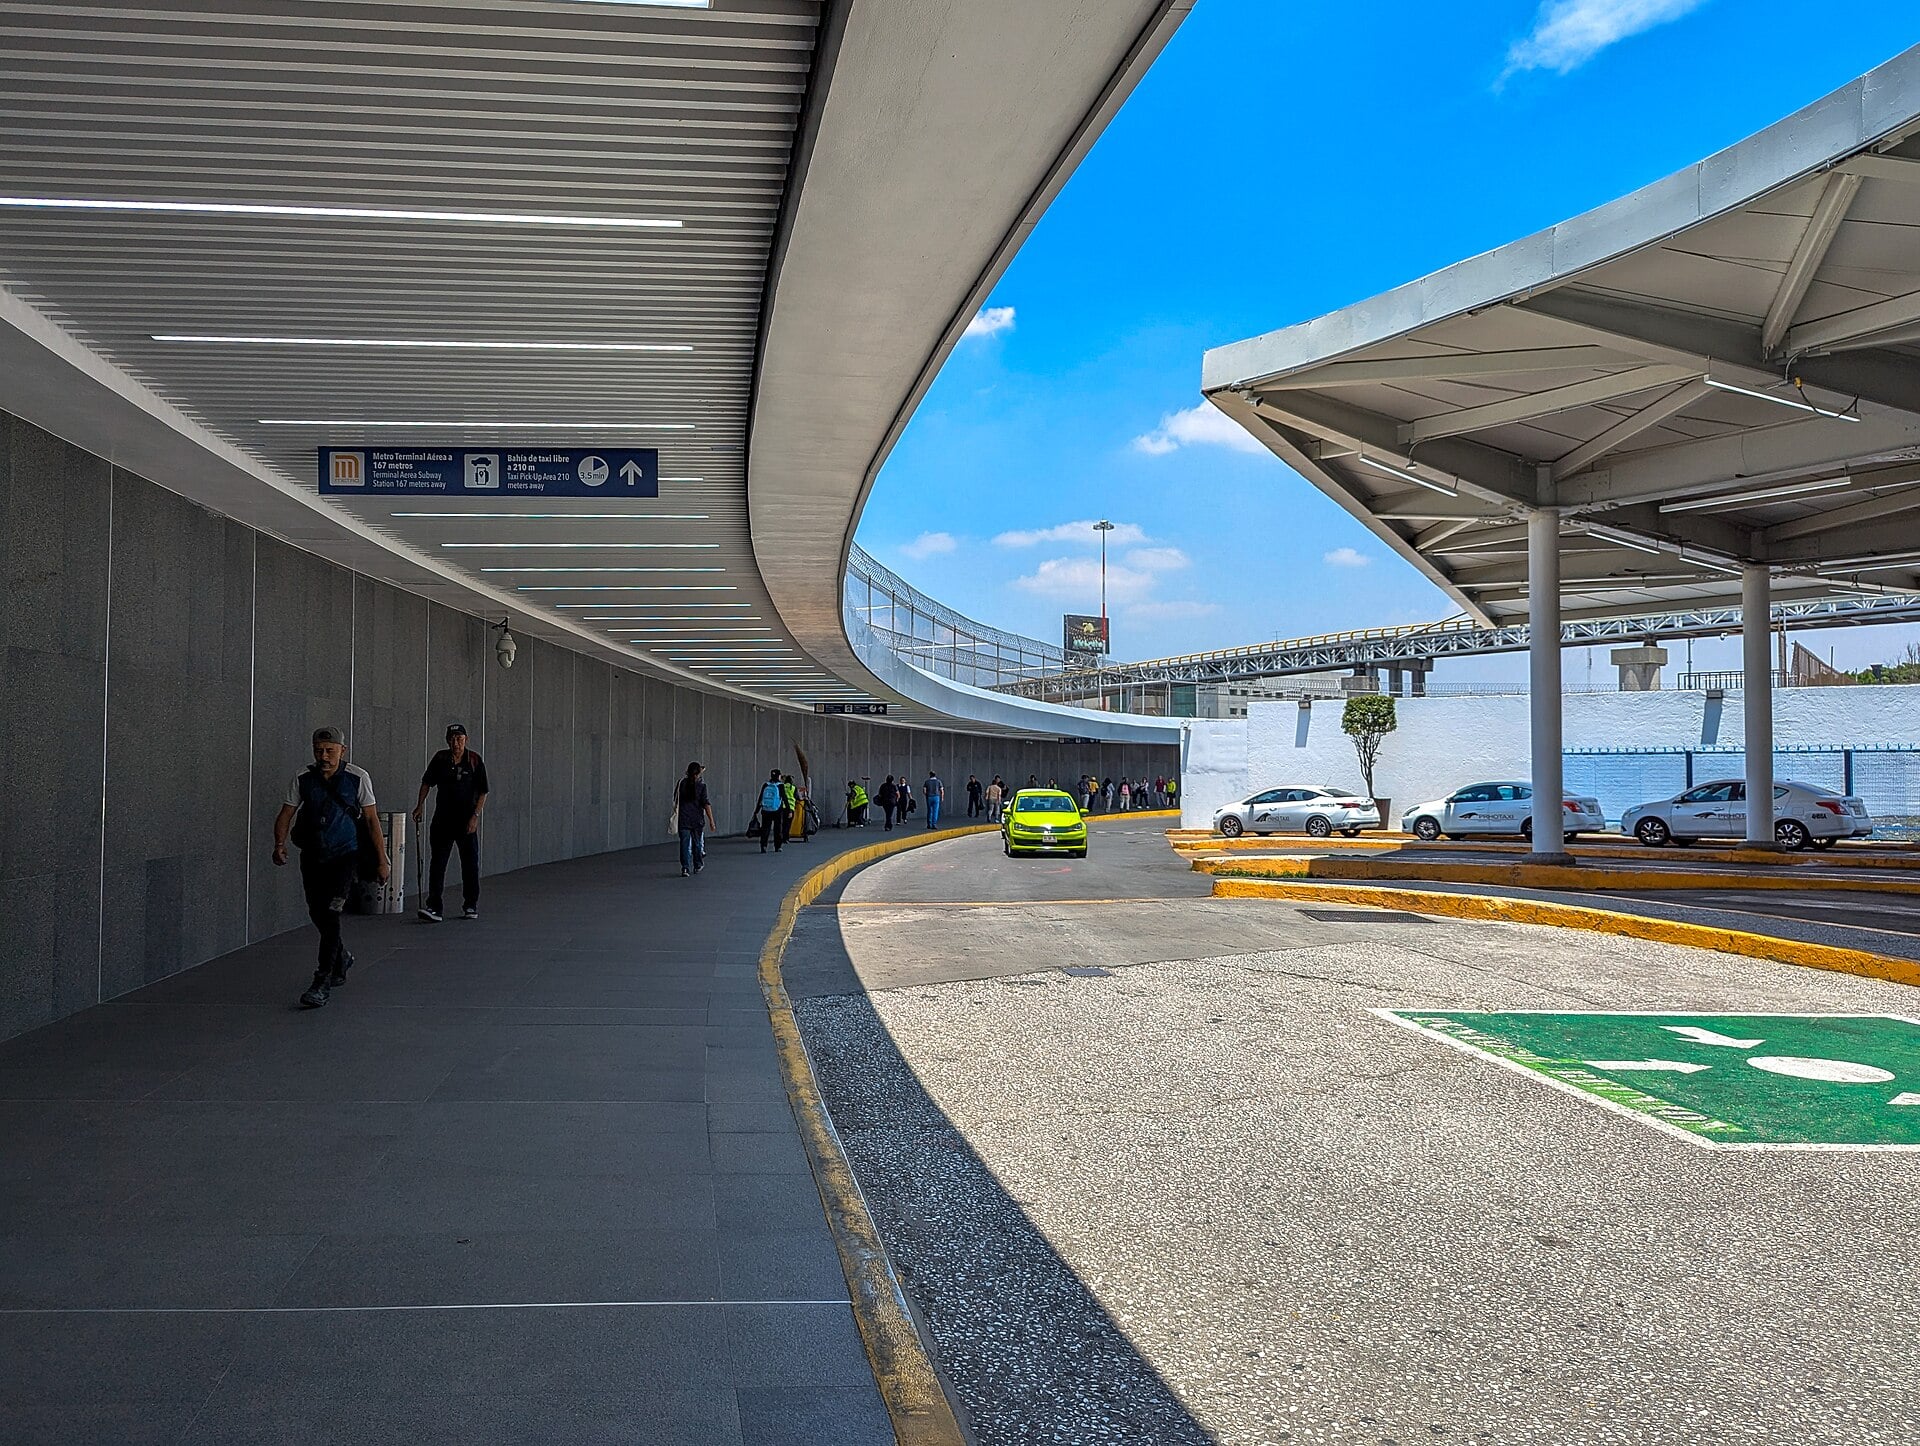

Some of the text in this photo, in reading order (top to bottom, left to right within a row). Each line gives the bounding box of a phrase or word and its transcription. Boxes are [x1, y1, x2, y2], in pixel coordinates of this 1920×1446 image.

[373, 453, 394, 461] Metro
[395, 453, 426, 461] Terminal
[427, 453, 447, 461] Aérea
[507, 454, 527, 462] Bahía
[418, 471, 442, 480] Subway
[520, 473, 542, 482] Pick-Up
[542, 473, 556, 481] Area
